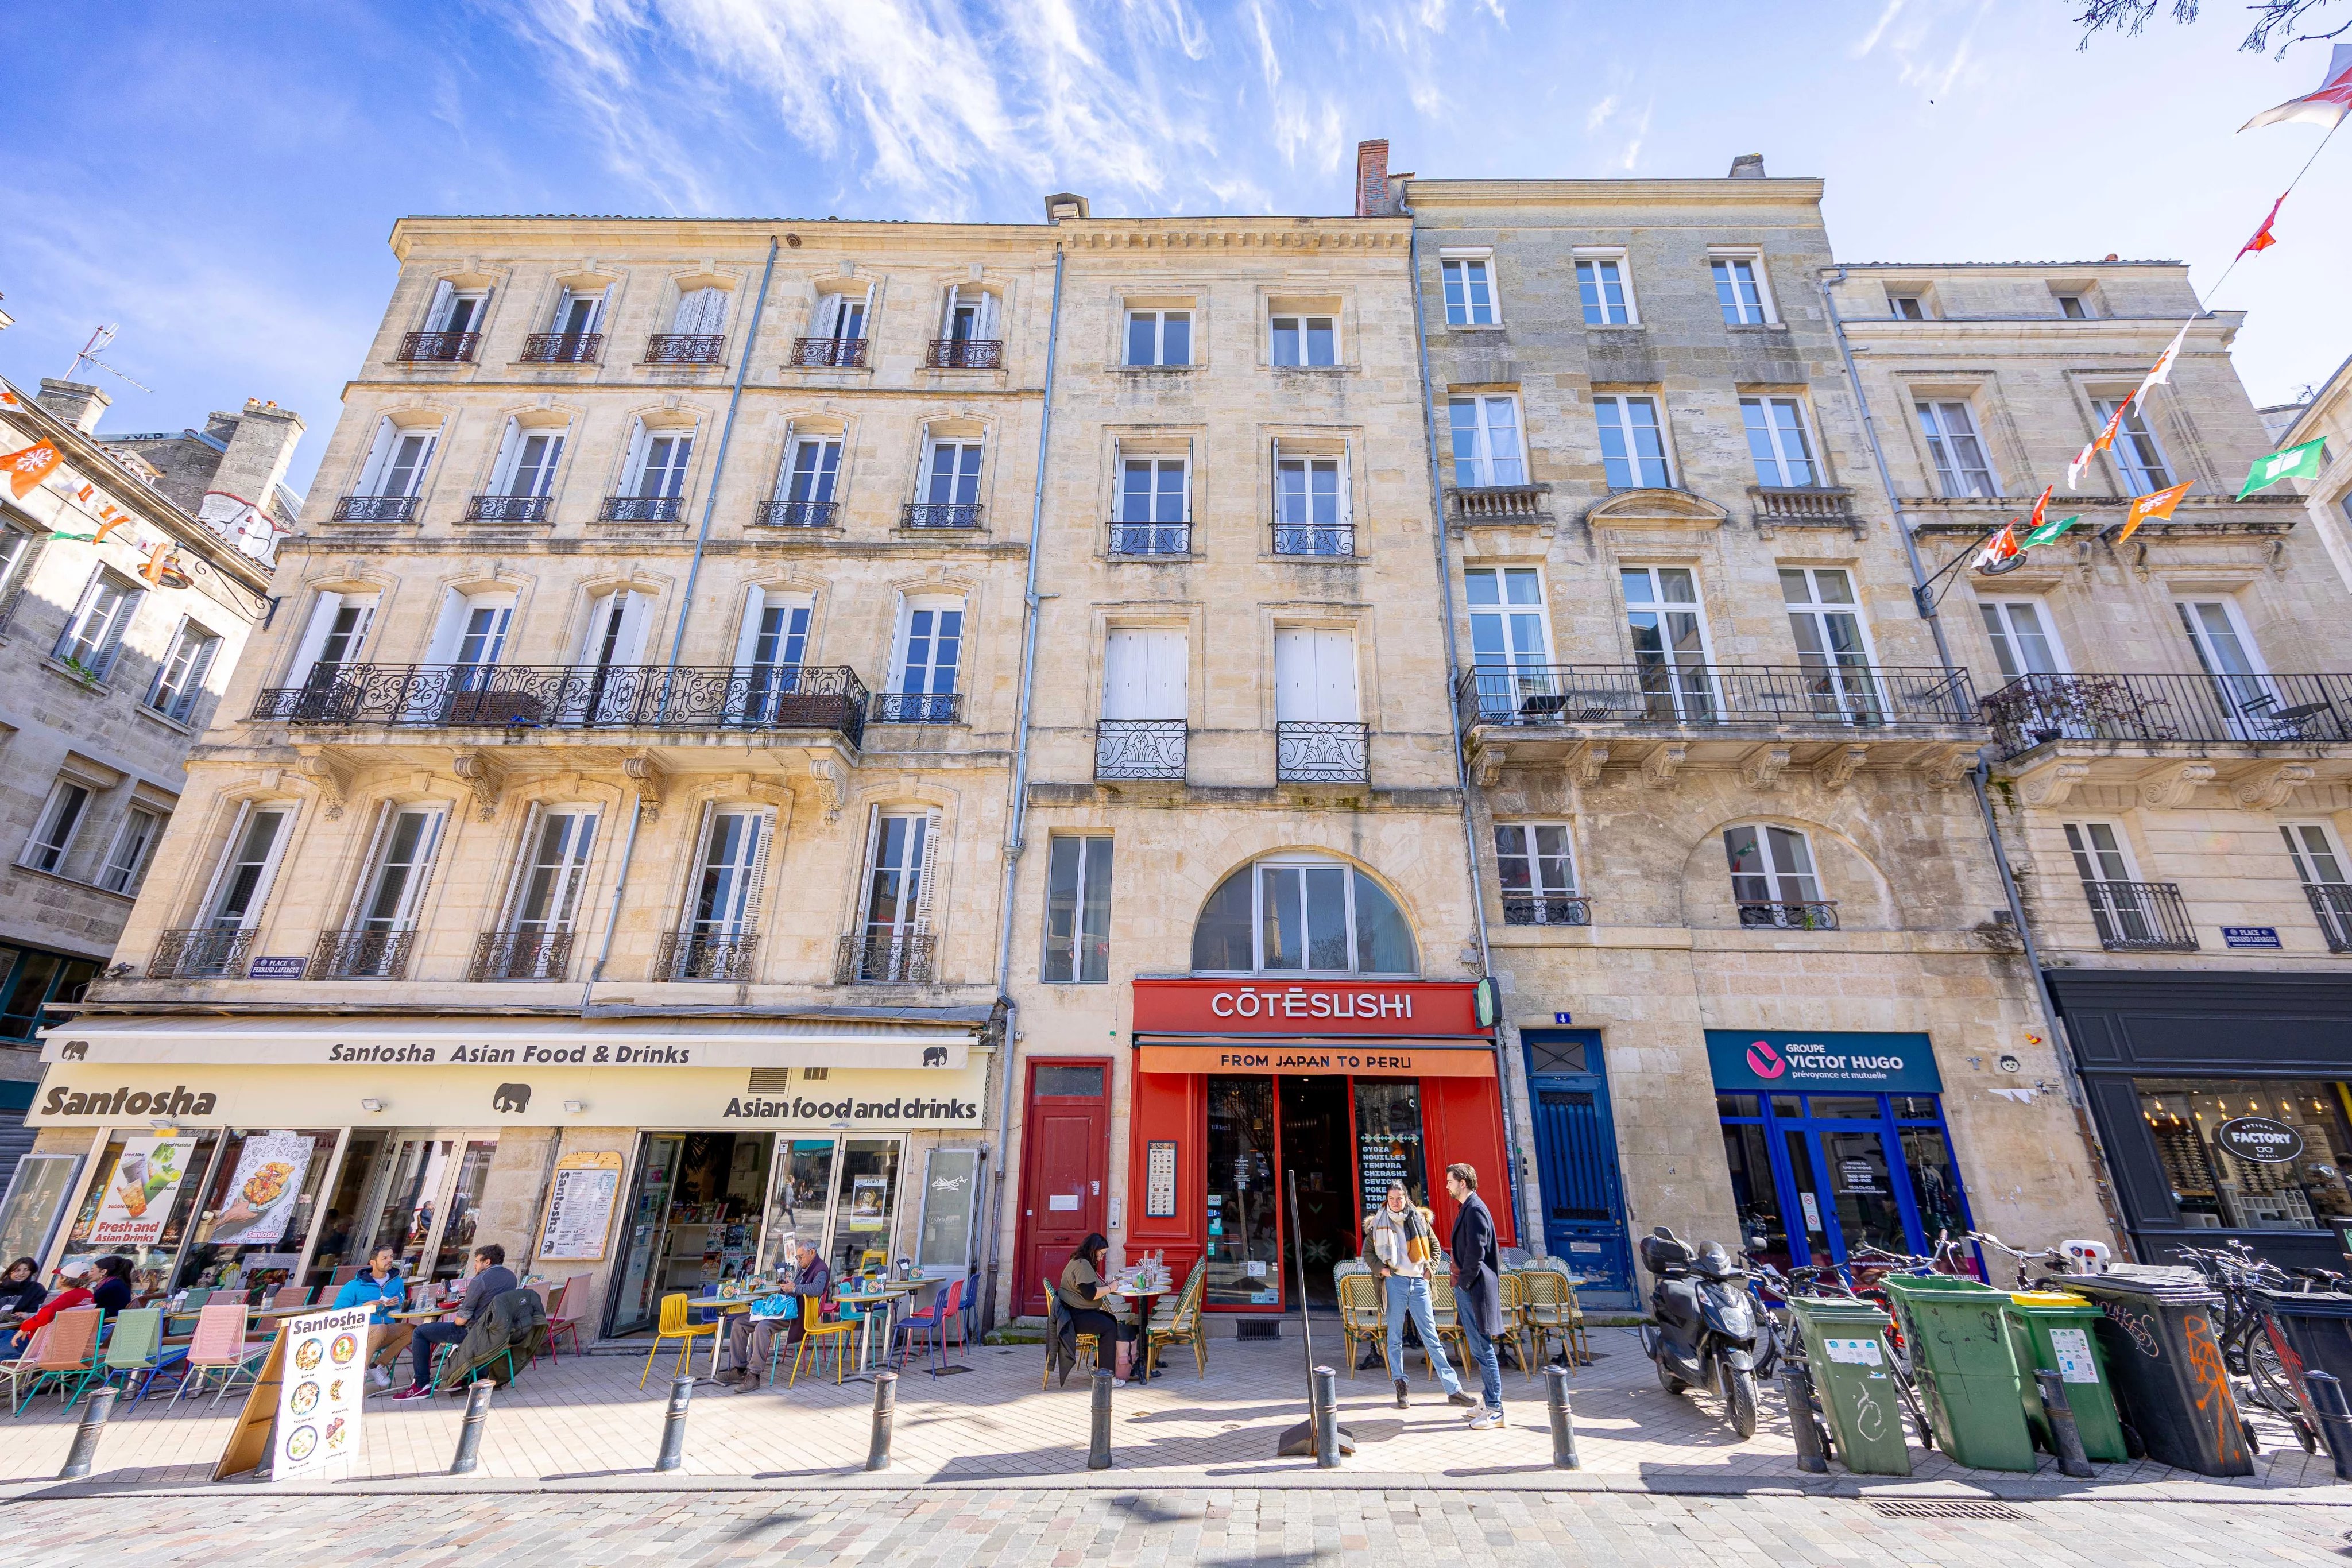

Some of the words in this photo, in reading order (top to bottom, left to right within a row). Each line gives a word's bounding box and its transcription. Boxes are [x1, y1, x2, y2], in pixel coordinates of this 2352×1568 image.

[1560, 1014, 1566, 1023] 4
[329, 1044, 435, 1062] Santosha
[450, 1044, 516, 1062] Asian
[522, 1045, 587, 1063] Food
[592, 1045, 609, 1063] &
[615, 1045, 690, 1063] Drinks
[1785, 1044, 1825, 1053] GROUPE
[1221, 1055, 1268, 1066] FROM
[1276, 1055, 1330, 1067] JAPAN
[1337, 1056, 1360, 1068] TO
[1367, 1056, 1411, 1068] PERU
[1850, 1056, 1904, 1070] HUGO
[1792, 1070, 1839, 1079] prévoyance
[41, 1085, 217, 1116] Santosha
[722, 1097, 789, 1118] Asian
[792, 1097, 853, 1118] food
[854, 1098, 902, 1119] and
[903, 1098, 977, 1119] drinks
[2242, 1123, 2274, 1131] OPTICAL
[2231, 1132, 2291, 1144] FACTORY
[548, 1172, 570, 1234] Santosha
[98, 1221, 133, 1232] Fresh
[133, 1222, 160, 1232] and
[94, 1234, 121, 1242] Asian
[122, 1234, 154, 1242] Drinks
[247, 1230, 279, 1238] Santosha
[293, 1311, 365, 1335] Santosha
